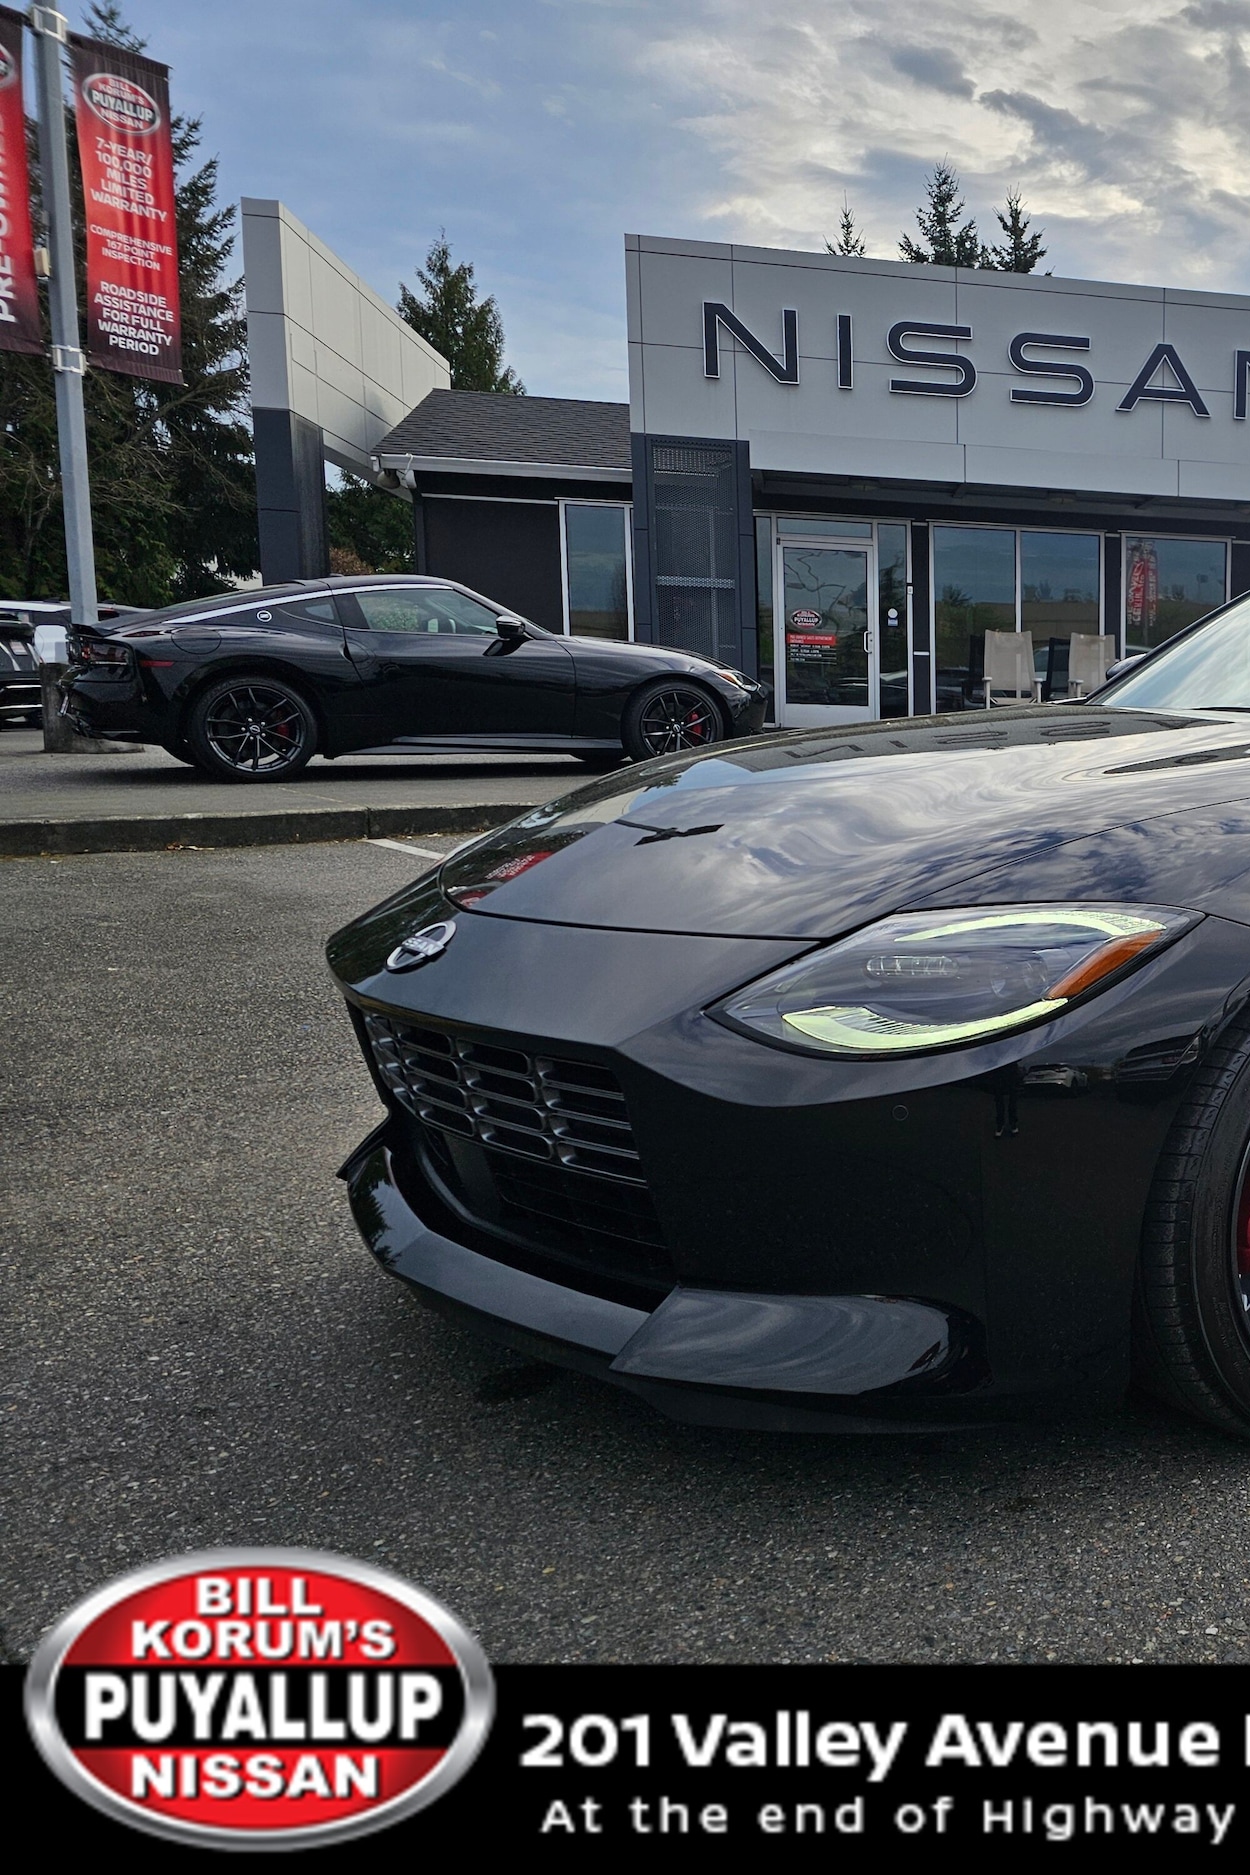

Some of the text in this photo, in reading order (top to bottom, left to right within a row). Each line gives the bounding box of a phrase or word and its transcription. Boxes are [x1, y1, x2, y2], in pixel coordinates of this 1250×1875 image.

[98, 83, 145, 105] KORUM'S
[108, 78, 132, 93] BILL
[91, 90, 153, 122] PUYALLUP
[100, 108, 144, 129] NISSAN
[95, 136, 153, 165] 7-YEAR/
[95, 150, 152, 179] 100,000
[106, 167, 147, 190] MILES
[90, 188, 167, 222] WARRANTY
[101, 179, 155, 206] LIMITED
[90, 224, 173, 256] COMPREHENSIVE
[106, 239, 155, 260] 167 POINT
[101, 247, 161, 271] INSPECTION
[94, 292, 174, 322] ASSISTANCE
[100, 280, 167, 308] ROADSIDE
[97, 319, 172, 346] WARRANTY
[102, 307, 165, 333] FOR FULL
[108, 334, 160, 356] PERIOD
